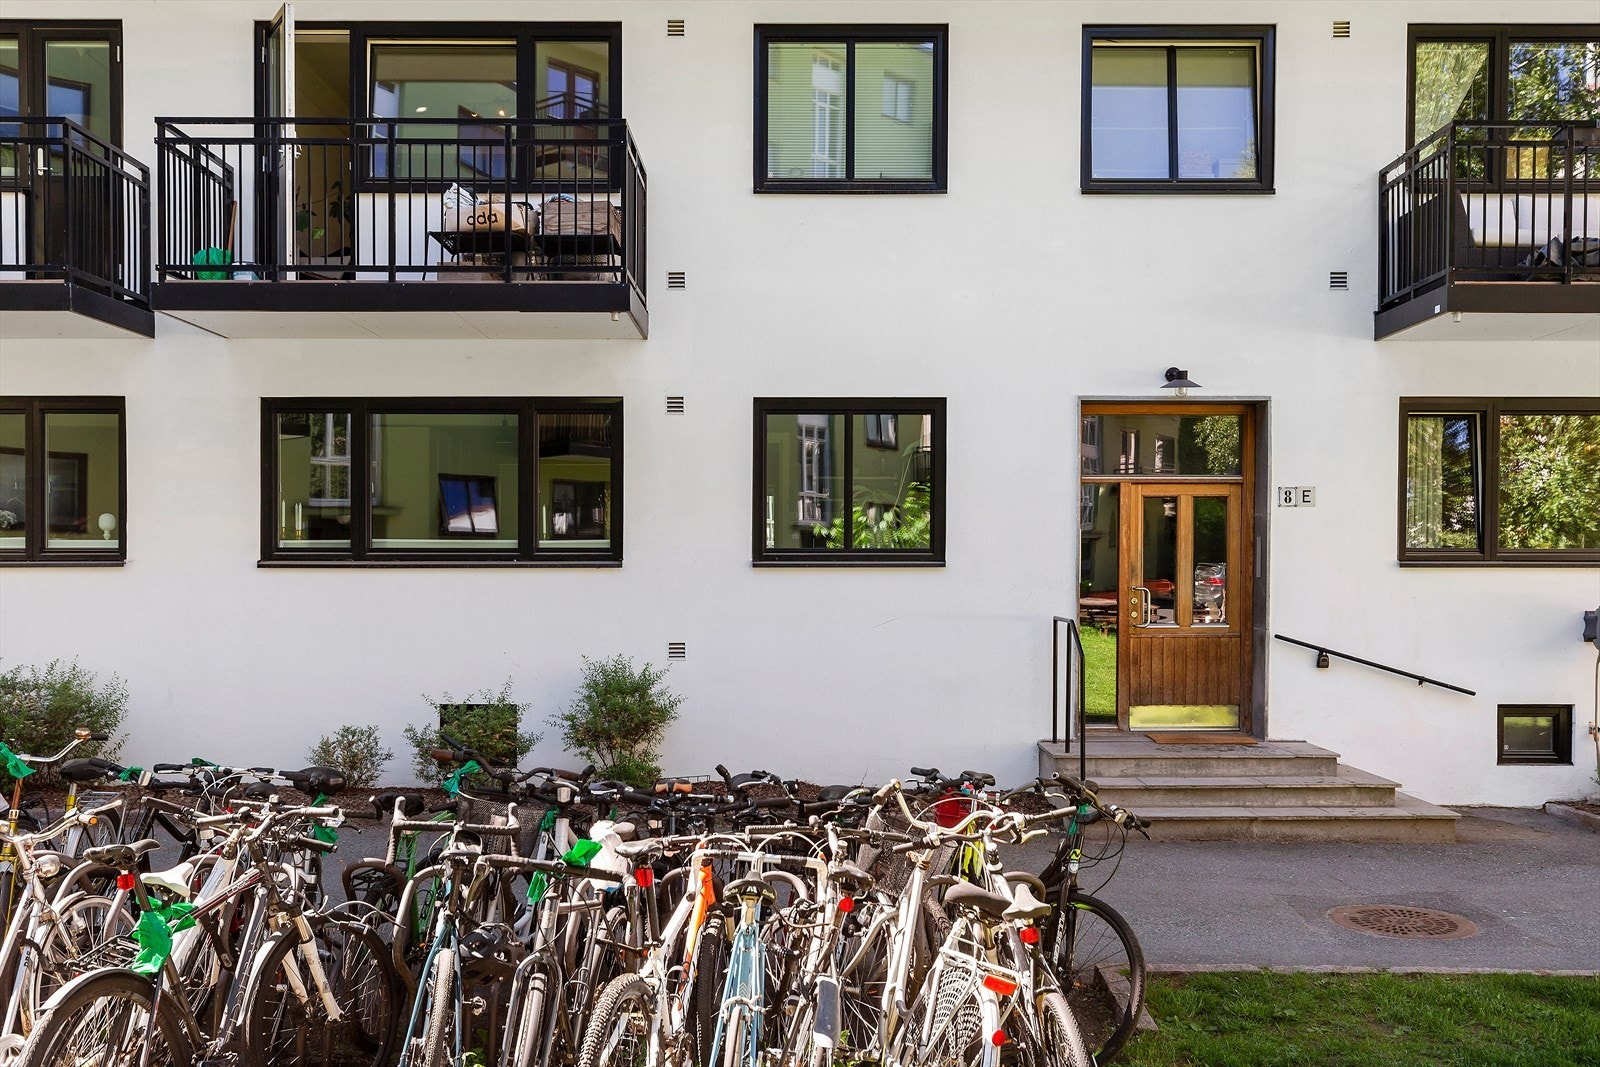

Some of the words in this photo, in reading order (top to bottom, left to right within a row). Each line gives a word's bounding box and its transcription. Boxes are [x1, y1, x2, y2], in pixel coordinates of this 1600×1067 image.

[467, 211, 498, 226] oda
[1284, 489, 1292, 504] 8
[1302, 489, 1311, 503] E
